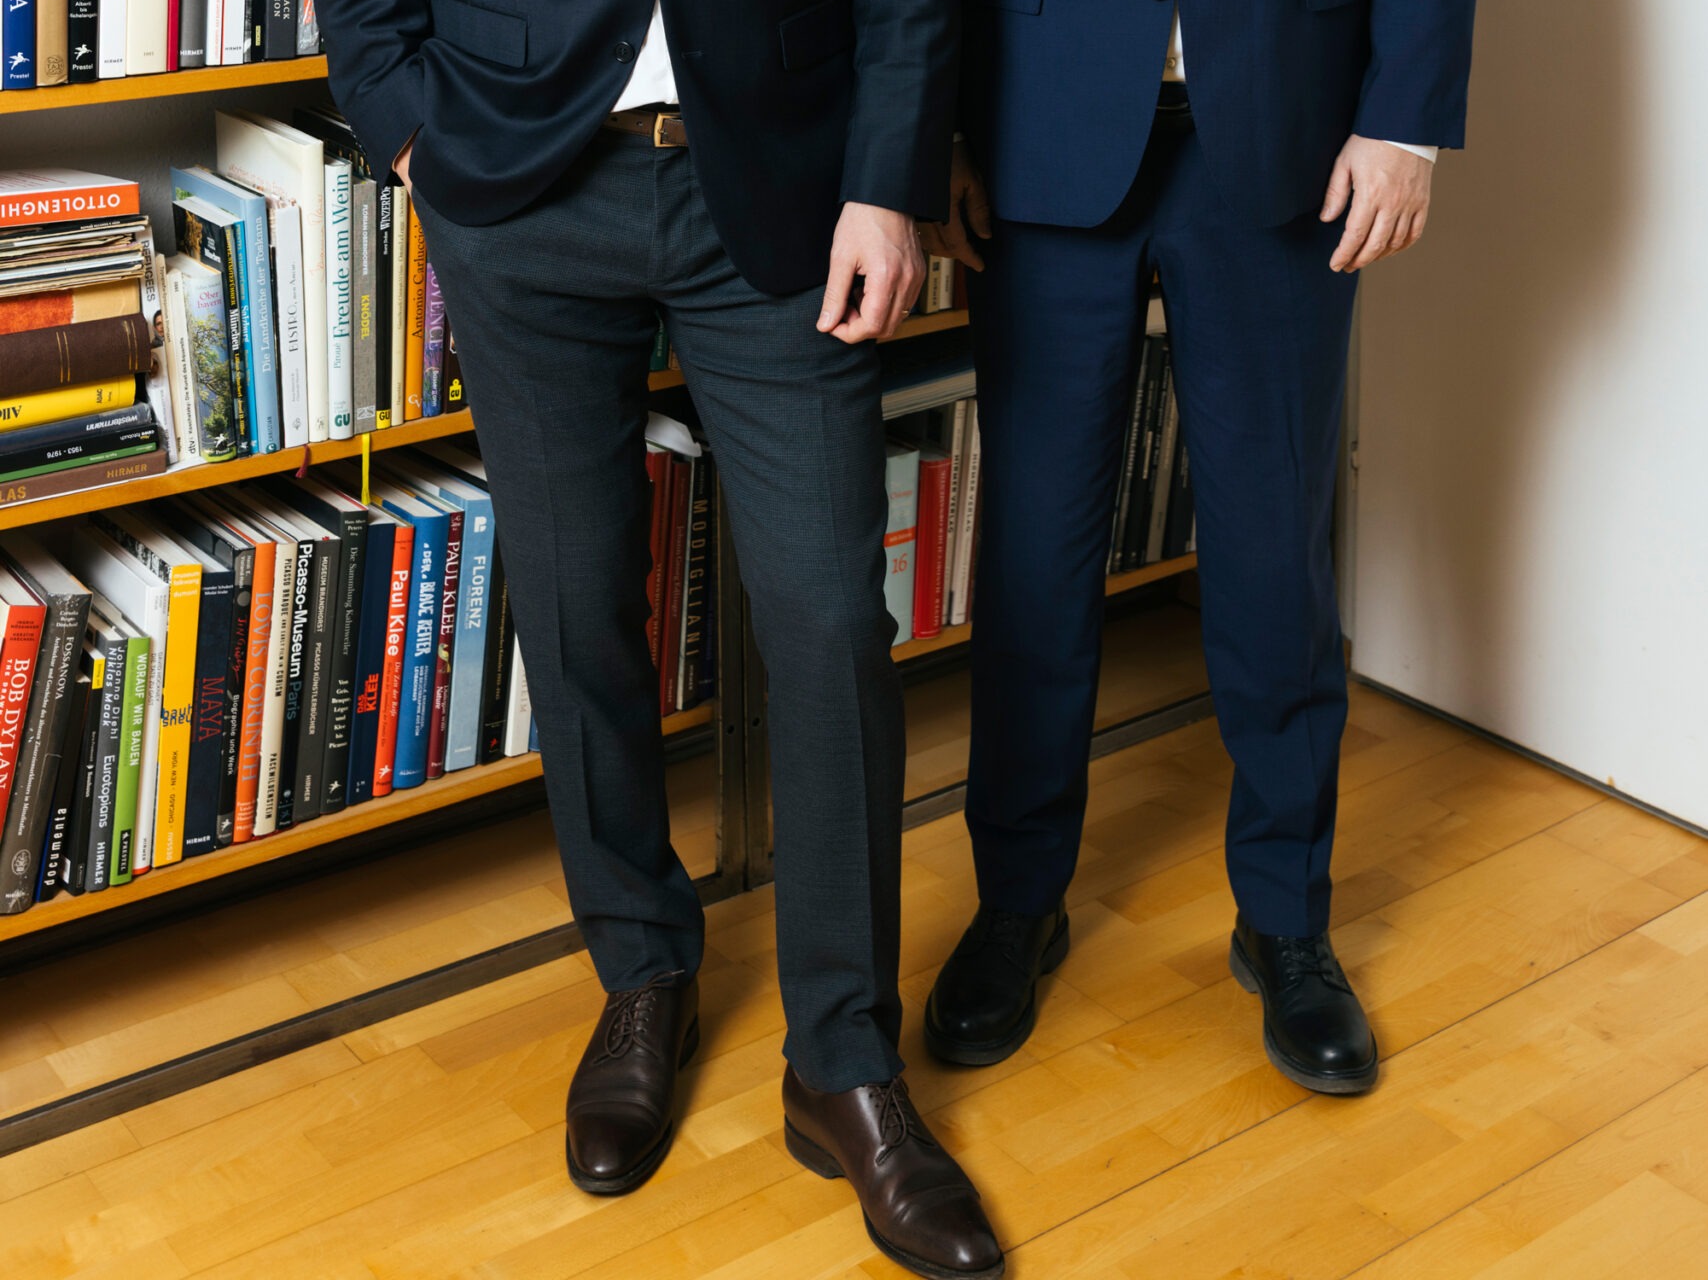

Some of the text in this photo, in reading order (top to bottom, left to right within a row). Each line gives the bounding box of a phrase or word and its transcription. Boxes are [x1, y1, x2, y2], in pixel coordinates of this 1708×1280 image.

[1, 194, 121, 218] OTTOLENGHI
[332, 174, 350, 338] Freude am Wein
[255, 216, 272, 373] Die Landküche der Toskana
[360, 294, 372, 340] KNÖDEL
[86, 415, 138, 431] westermann
[335, 413, 350, 427] GU
[106, 463, 148, 478] HIRMER
[947, 454, 961, 534] HIRMER VERLAG
[965, 453, 979, 533] HIRMER VERLAG
[417, 581, 436, 617] BLAUE
[421, 551, 432, 573] DER
[440, 541, 461, 636] PAUL KLEE
[468, 555, 487, 630] FLORENZ
[685, 498, 709, 657] MODIGLIANI
[891, 553, 908, 574] 16
[286, 543, 314, 720] Picasso-Museum Paris
[387, 570, 409, 656] Paul Klee
[413, 619, 434, 657] REITER
[8, 657, 31, 704] BOB
[55, 636, 75, 700] FOSSANOVA
[102, 647, 117, 728] Niklas Maak
[110, 646, 125, 740] Johanna Diehl
[241, 591, 272, 783] LOVIS CORINTH
[129, 652, 148, 767] WORAUF WIR BAUEN
[198, 675, 225, 743] MAYA
[98, 754, 116, 829] Eurotopians
[43, 808, 68, 886] documenta
[94, 841, 106, 885] HIRMER
